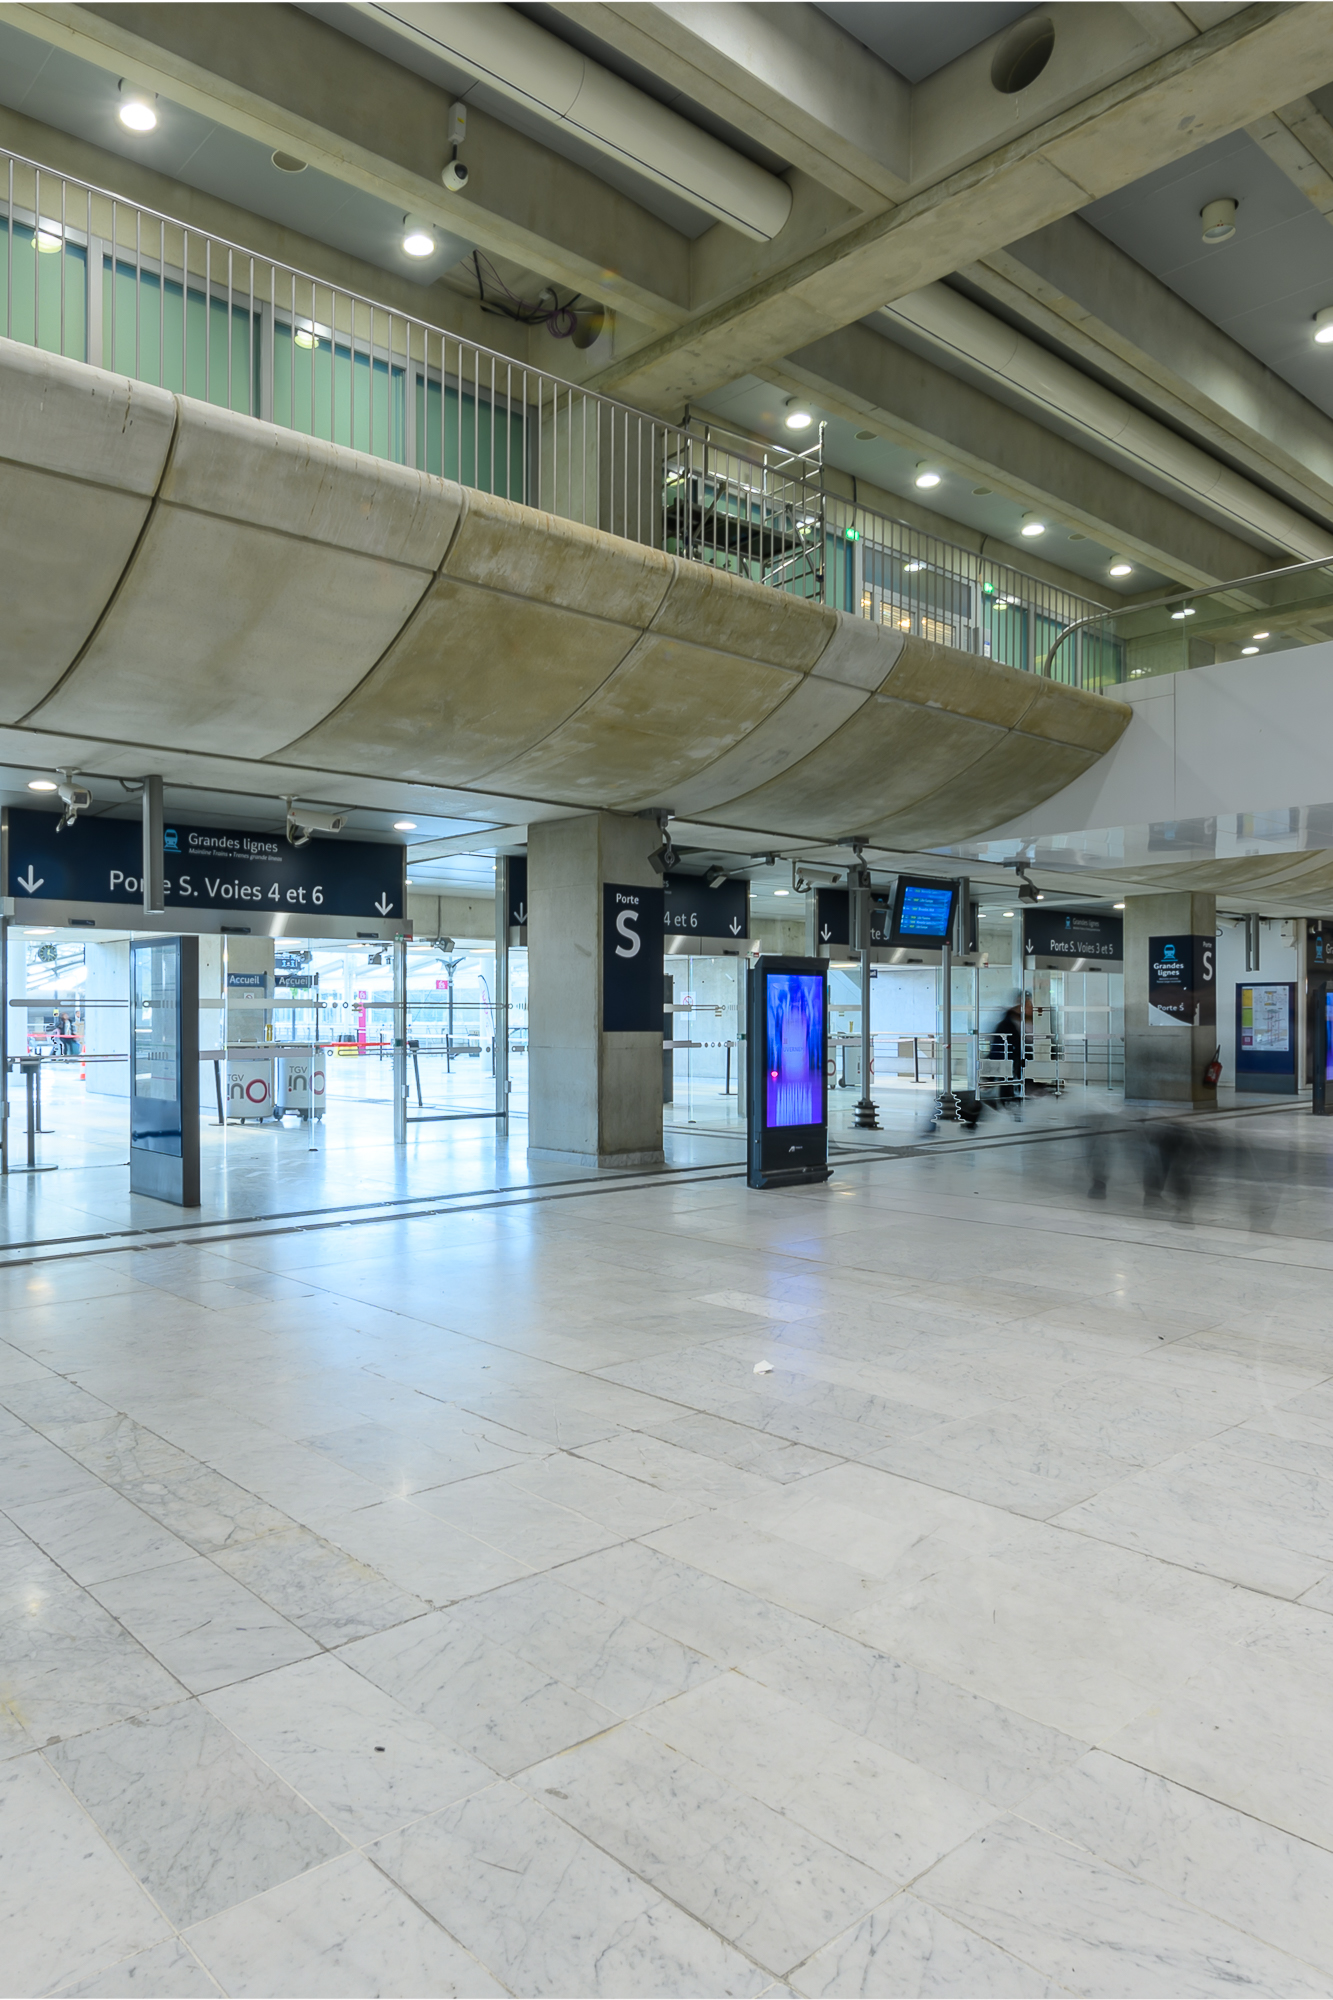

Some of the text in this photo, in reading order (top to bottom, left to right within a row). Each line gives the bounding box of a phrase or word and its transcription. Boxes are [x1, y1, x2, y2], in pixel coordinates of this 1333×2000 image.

[188, 832, 278, 853] Grandes lignes
[188, 848, 212, 856] Mainline
[212, 850, 229, 858] Trains
[109, 869, 324, 905] Poe S. Voies 4 et 6
[615, 892, 640, 905] Porte
[663, 910, 698, 928] 4 et 6
[1072, 917, 1088, 927] Grandes
[615, 909, 641, 958] S
[1050, 939, 1114, 955] Porte S. Voies 3 et 5
[1202, 940, 1212, 948] Porte
[1153, 962, 1185, 970] Grandes
[1202, 951, 1213, 981] S
[229, 975, 260, 984] Accueil
[1158, 969, 1180, 977] lignes
